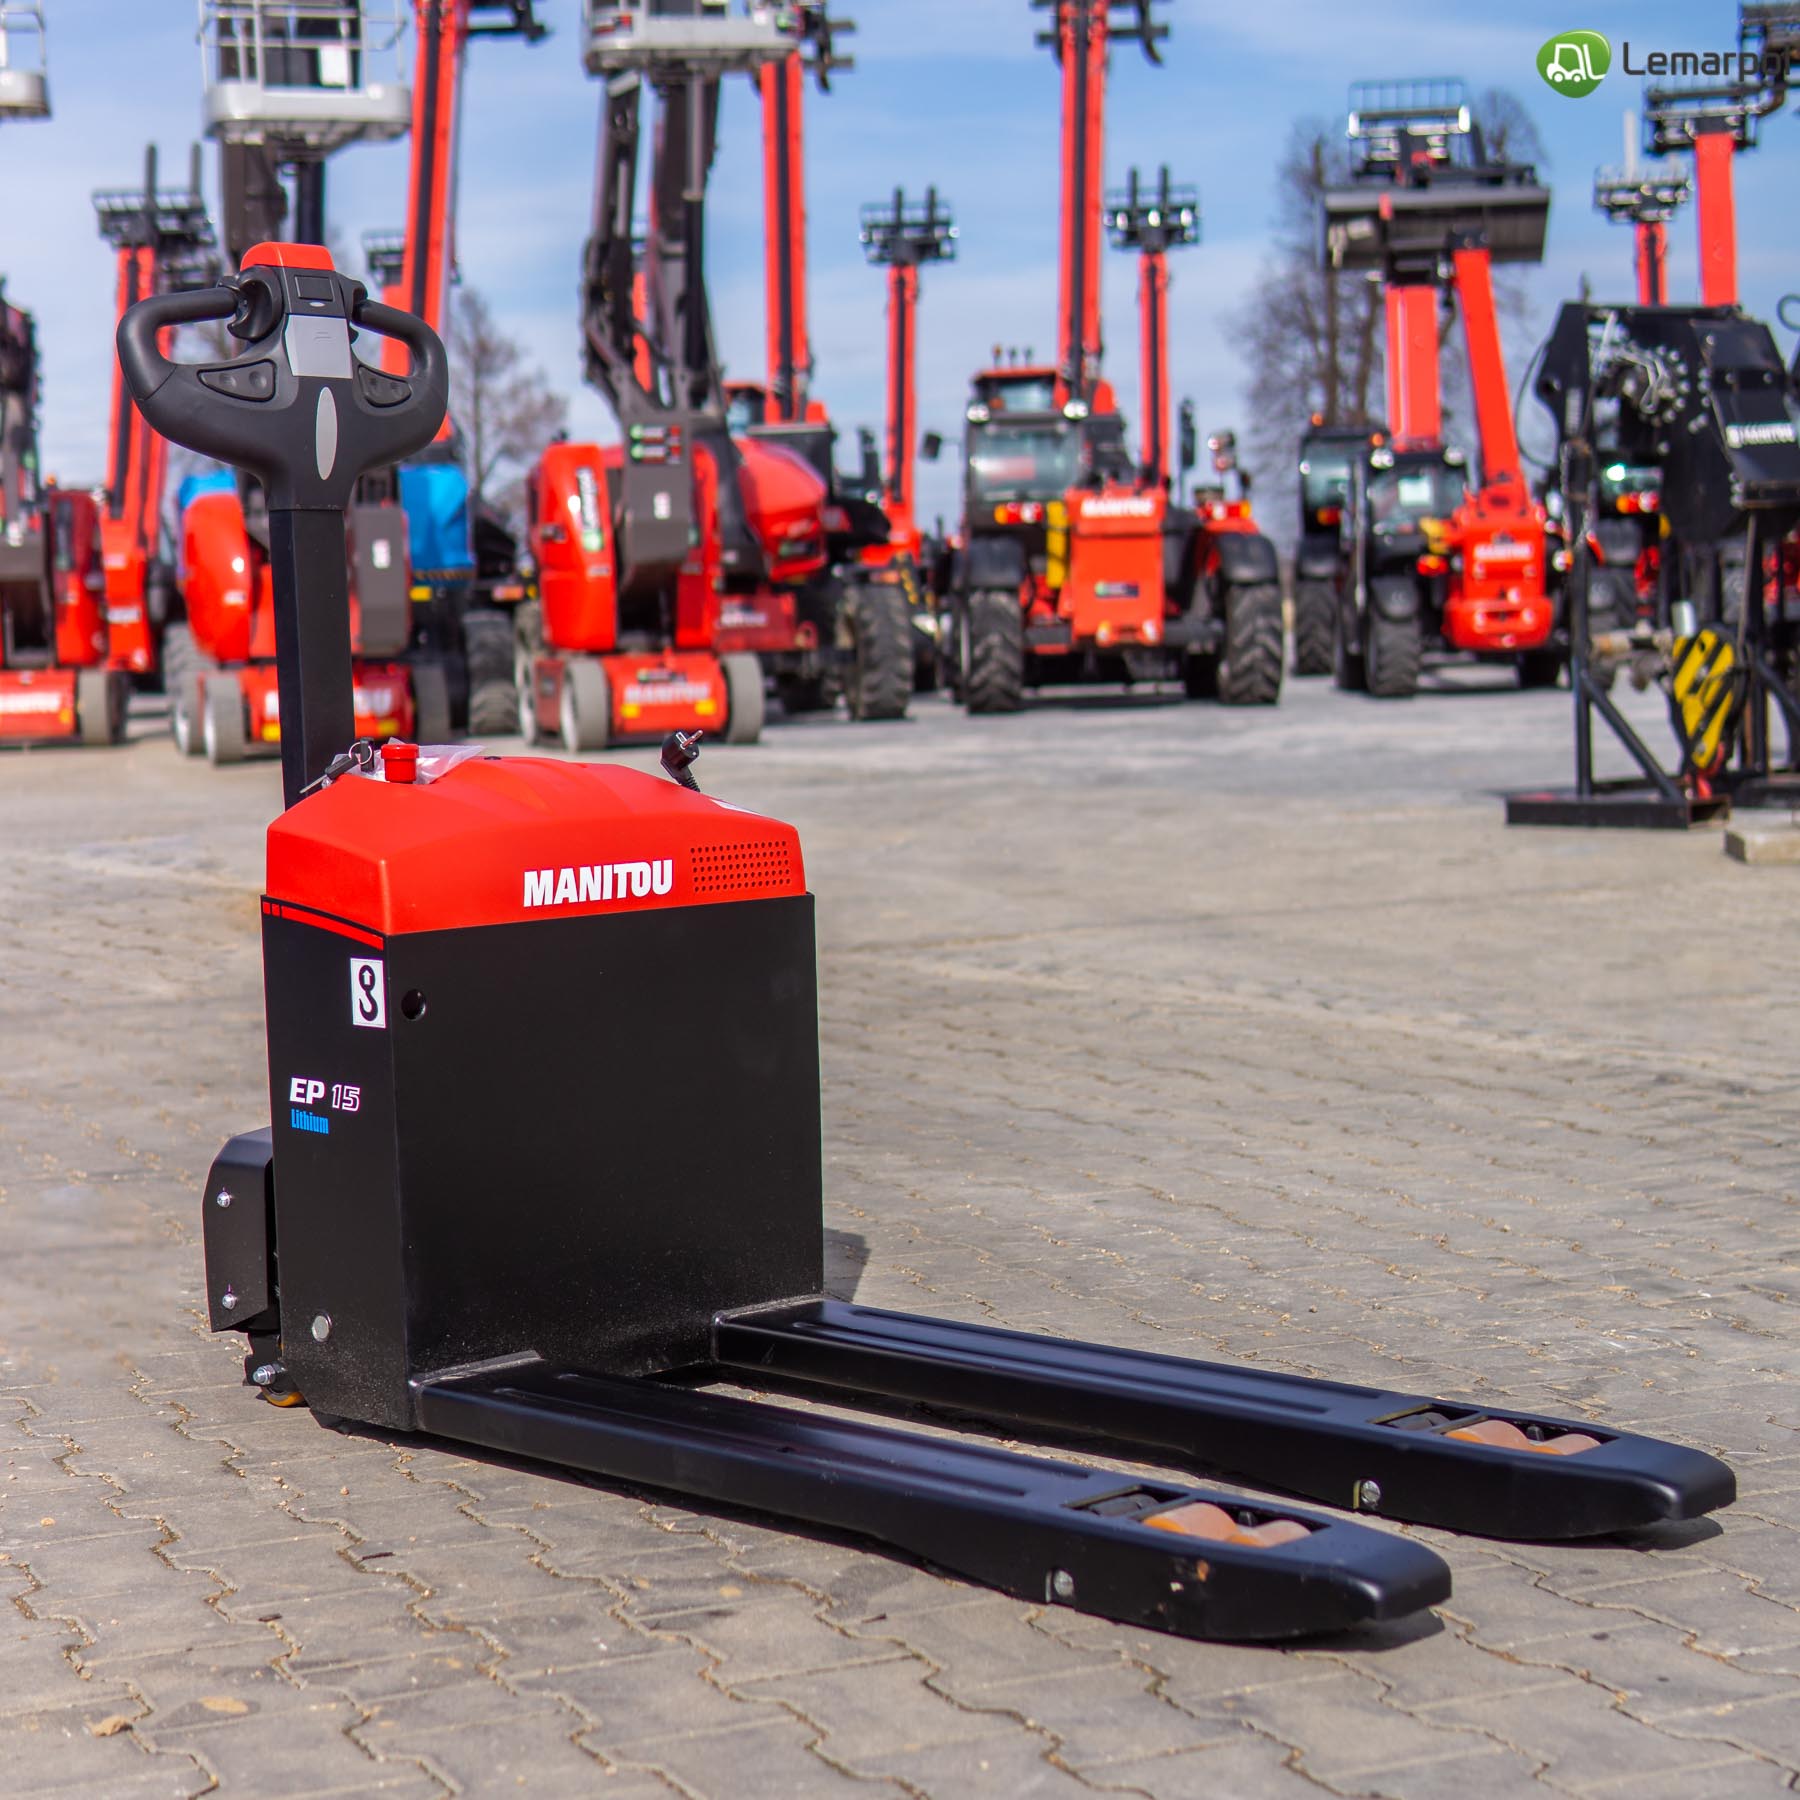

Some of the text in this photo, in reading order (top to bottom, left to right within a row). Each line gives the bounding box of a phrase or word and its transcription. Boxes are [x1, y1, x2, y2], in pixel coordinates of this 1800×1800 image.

[523, 859, 673, 907] MANITOU
[289, 1077, 361, 1112] EP 15
[291, 1108, 329, 1135] Lithium
